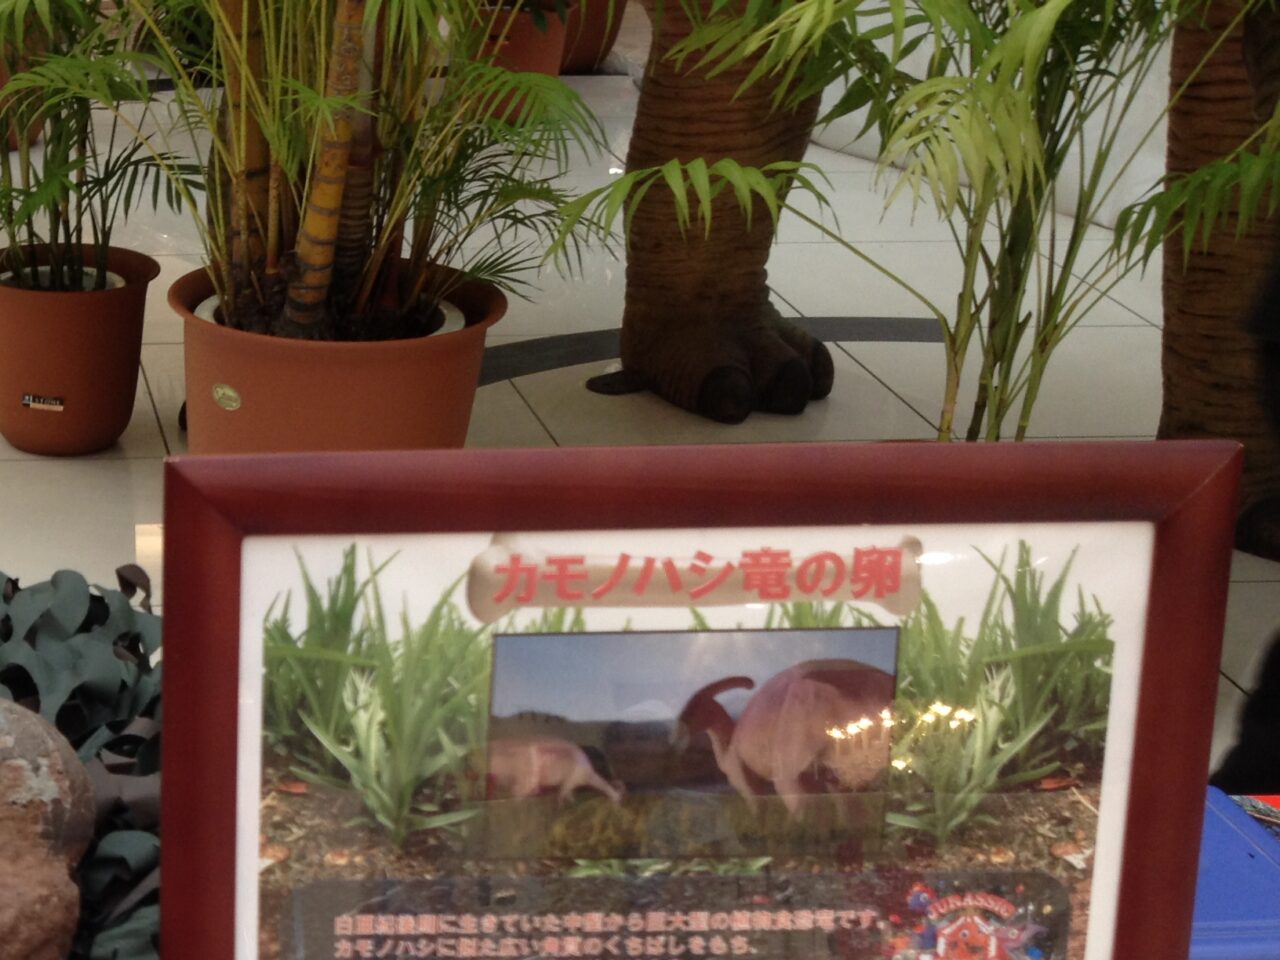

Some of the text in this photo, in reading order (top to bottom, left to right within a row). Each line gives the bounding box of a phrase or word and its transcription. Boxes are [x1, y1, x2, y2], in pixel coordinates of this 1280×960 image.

[491, 546, 903, 604] カモノハシ竜の卵
[927, 891, 1015, 920] JURASSIC
